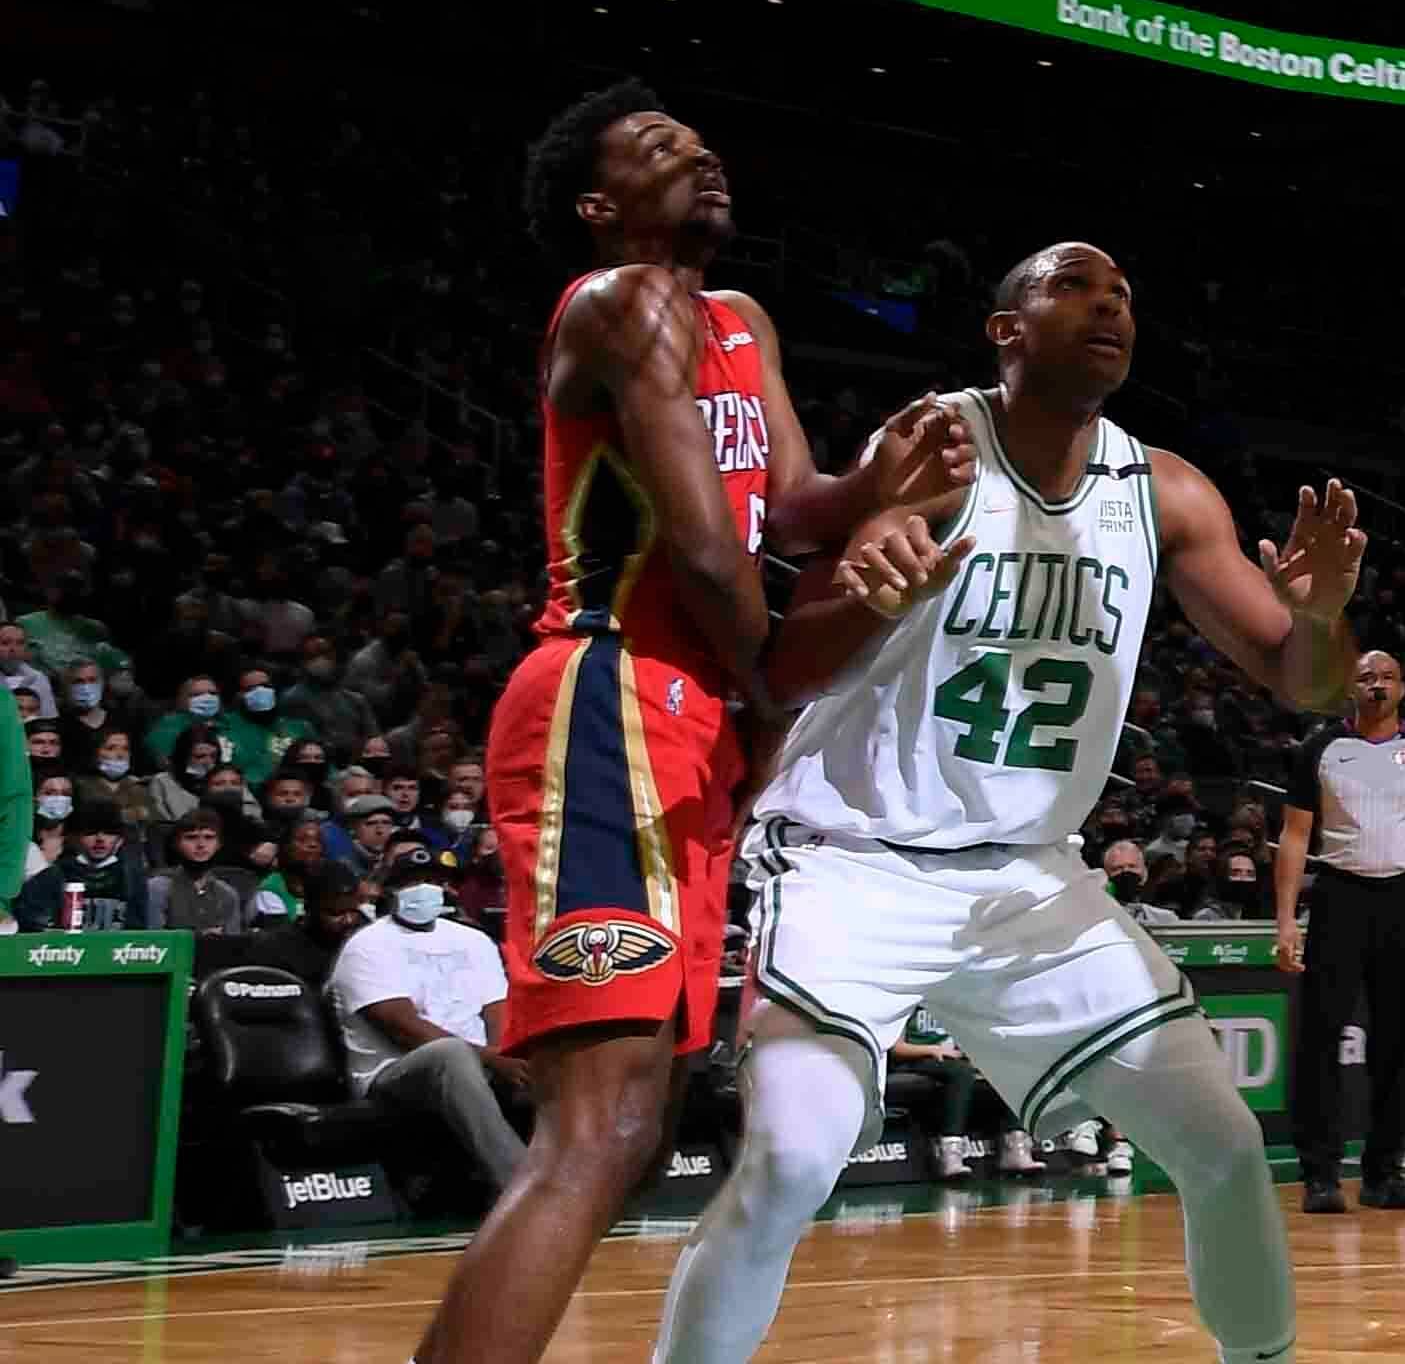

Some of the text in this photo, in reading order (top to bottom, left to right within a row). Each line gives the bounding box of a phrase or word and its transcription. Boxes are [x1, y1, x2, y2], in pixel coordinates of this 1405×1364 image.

[1134, 15, 1165, 45] of
[1168, 20, 1214, 58] the
[1219, 31, 1324, 79] Boston
[943, 552, 1129, 656] CELTICS
[933, 651, 1095, 772] 42
[27, 944, 86, 967] xfinity
[112, 942, 168, 965] xfinity
[282, 1171, 373, 1209] jetBlue
